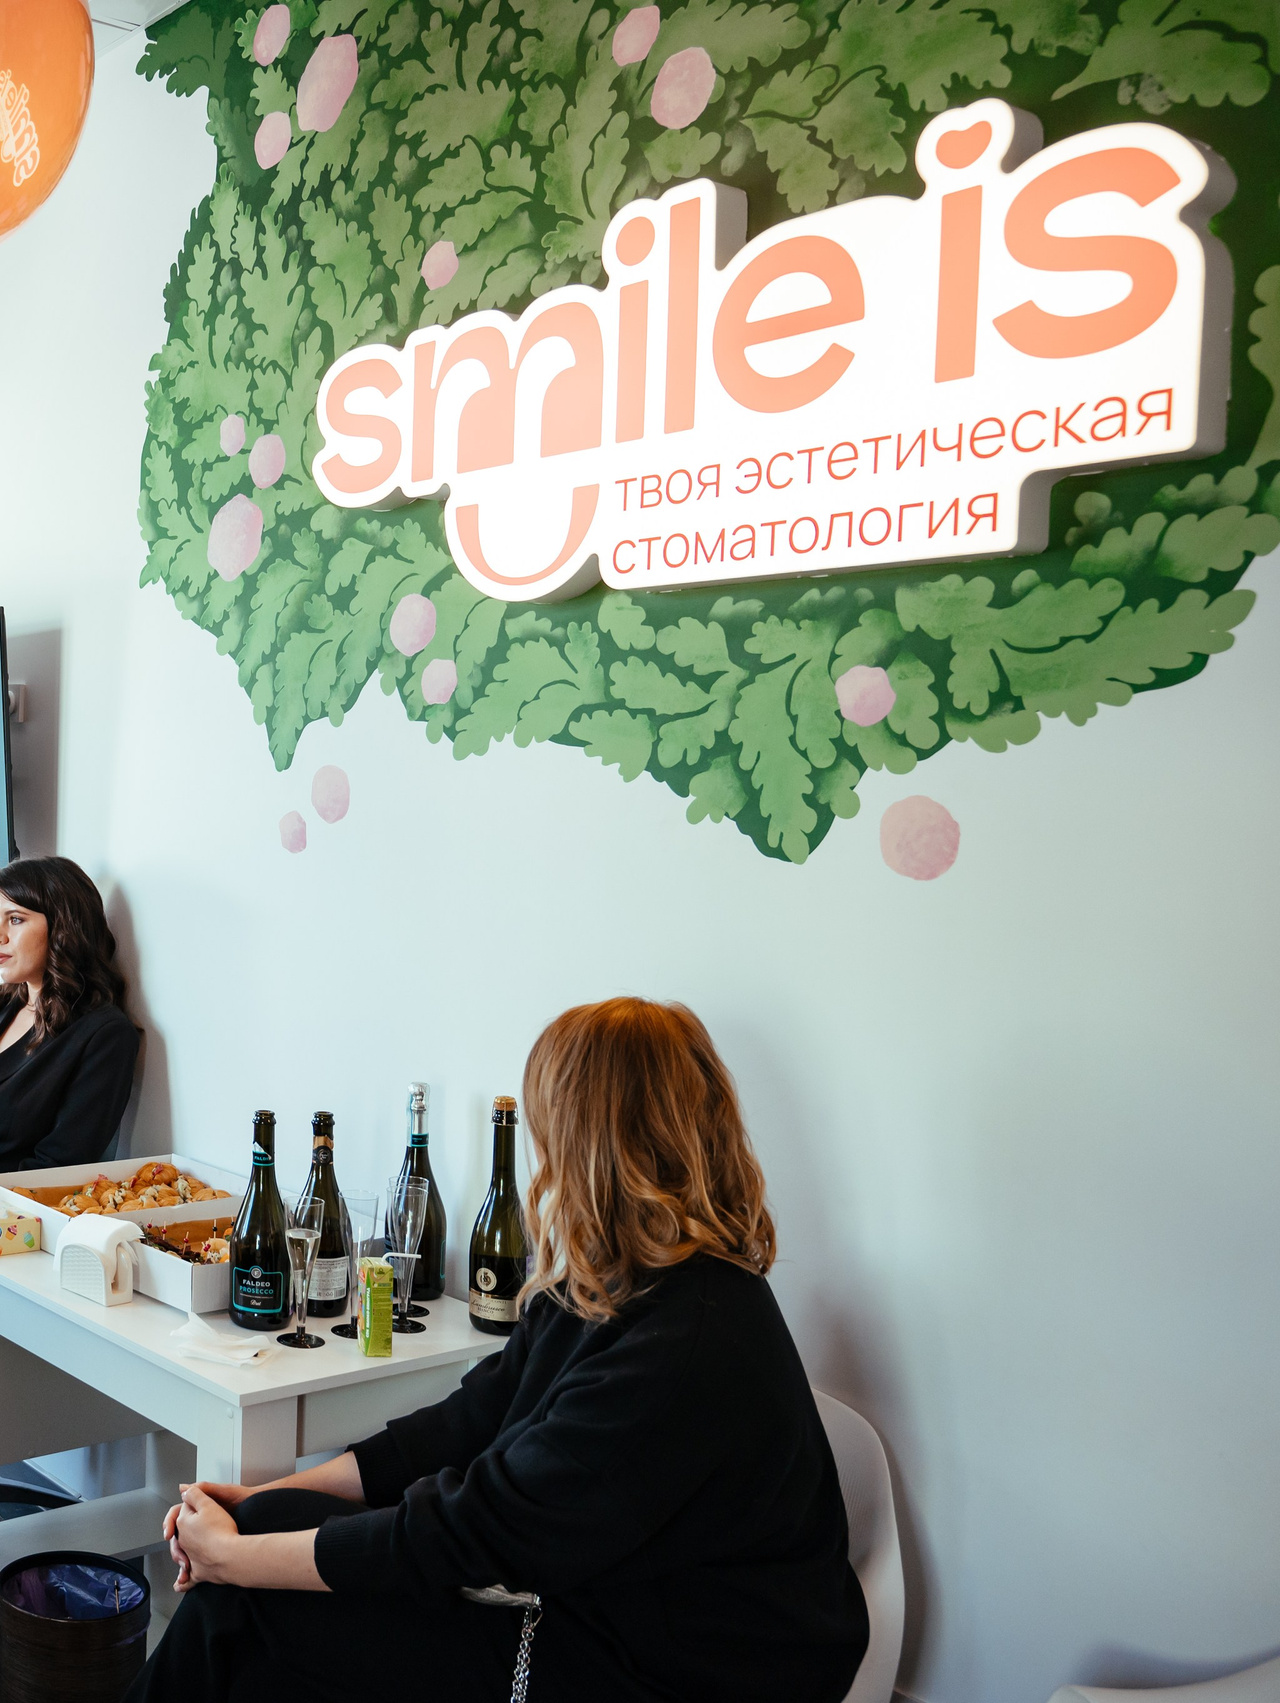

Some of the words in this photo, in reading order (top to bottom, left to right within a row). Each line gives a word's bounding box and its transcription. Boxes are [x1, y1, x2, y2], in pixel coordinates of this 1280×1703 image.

[321, 196, 865, 494] smile
[935, 120, 1181, 384] is
[615, 463, 721, 512] твоя
[734, 387, 1173, 495] эстетическая
[612, 492, 999, 575] стоматология
[239, 1285, 274, 1295] PROSECCO
[242, 1279, 271, 1287] FALDEO
